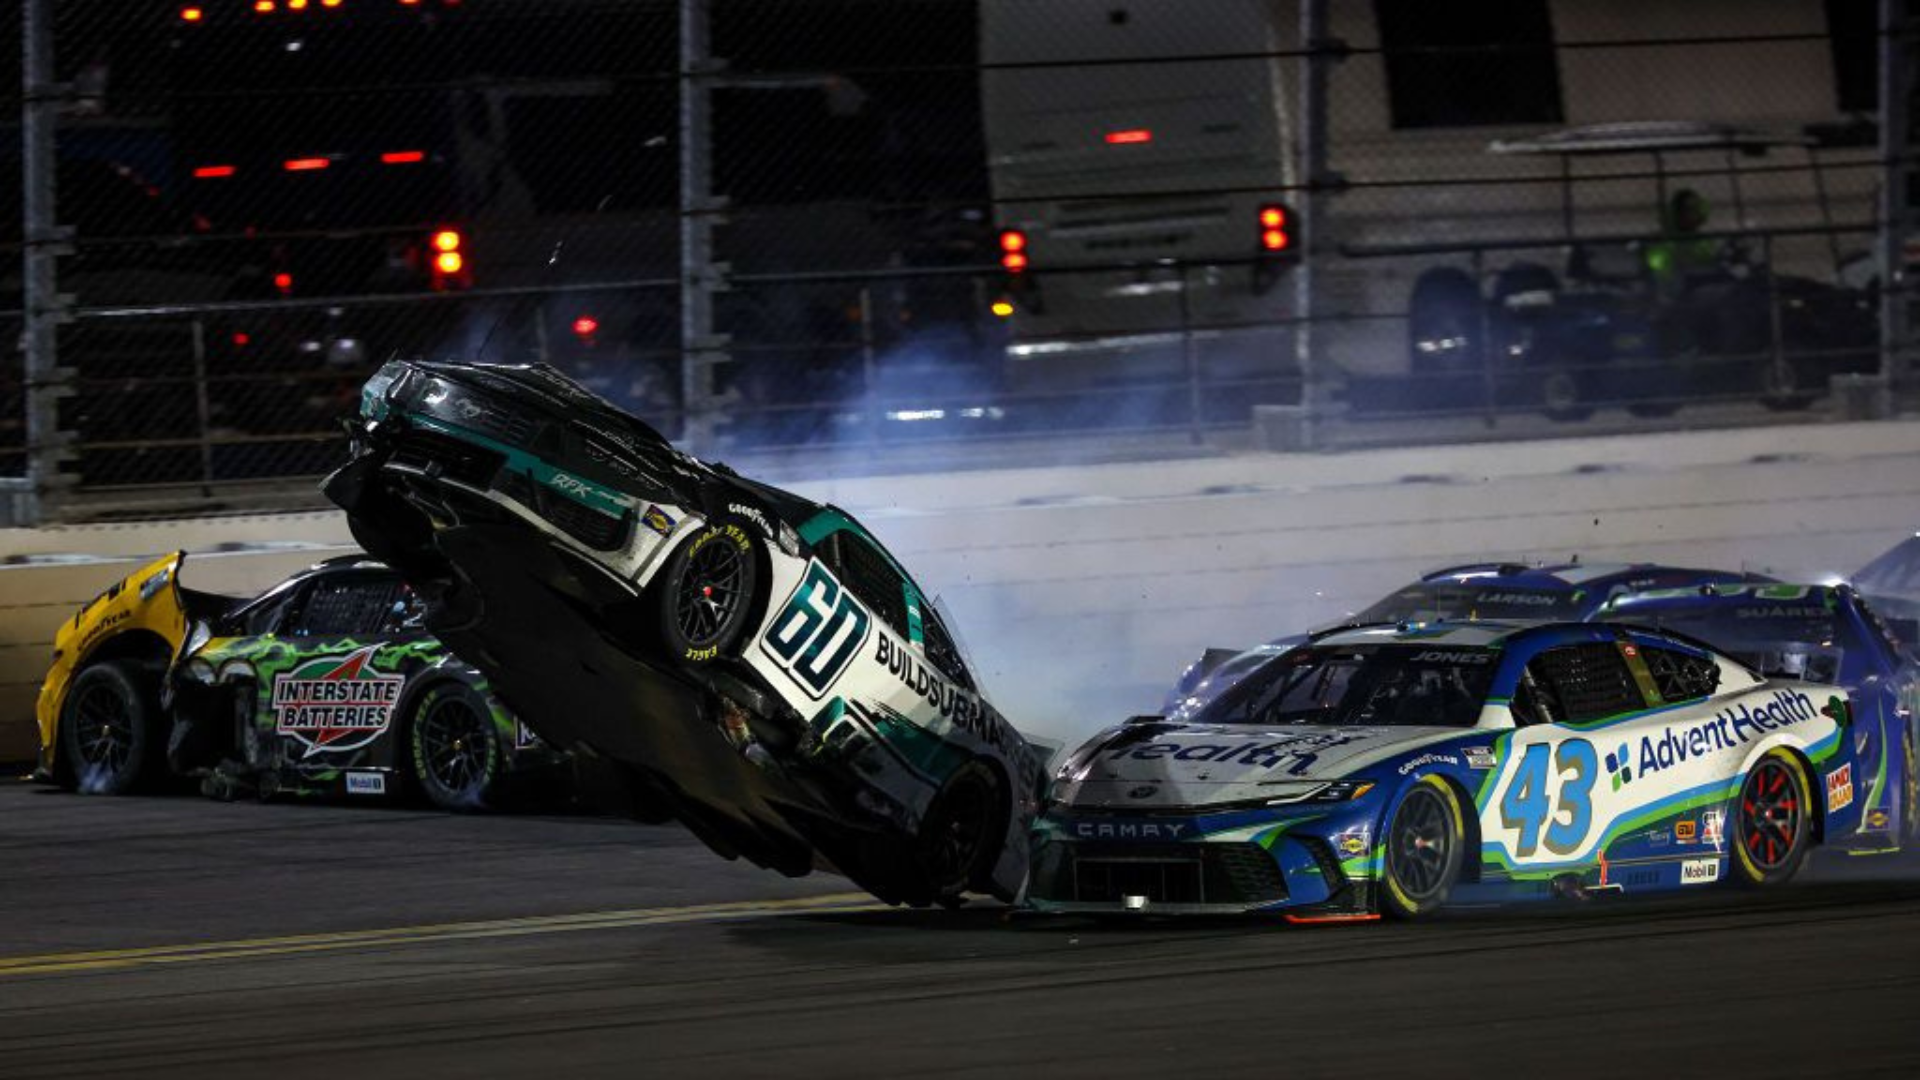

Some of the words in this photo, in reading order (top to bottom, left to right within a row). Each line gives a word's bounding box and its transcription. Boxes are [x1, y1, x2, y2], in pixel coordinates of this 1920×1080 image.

[728, 502, 774, 538] GOODYEAR
[1476, 592, 1557, 606] LARSON
[760, 556, 872, 700] 60
[1409, 651, 1491, 665] JONES
[279, 682, 397, 701] INTERSTATE
[284, 706, 387, 727] BATTERIES
[1638, 687, 1818, 779] AdventHealth
[1398, 753, 1458, 775] GOODYEAR
[350, 777, 371, 789] Mobil
[1500, 737, 1598, 857] 43
[1077, 823, 1185, 838] CAMRY
[1685, 865, 1706, 878] Mobil
